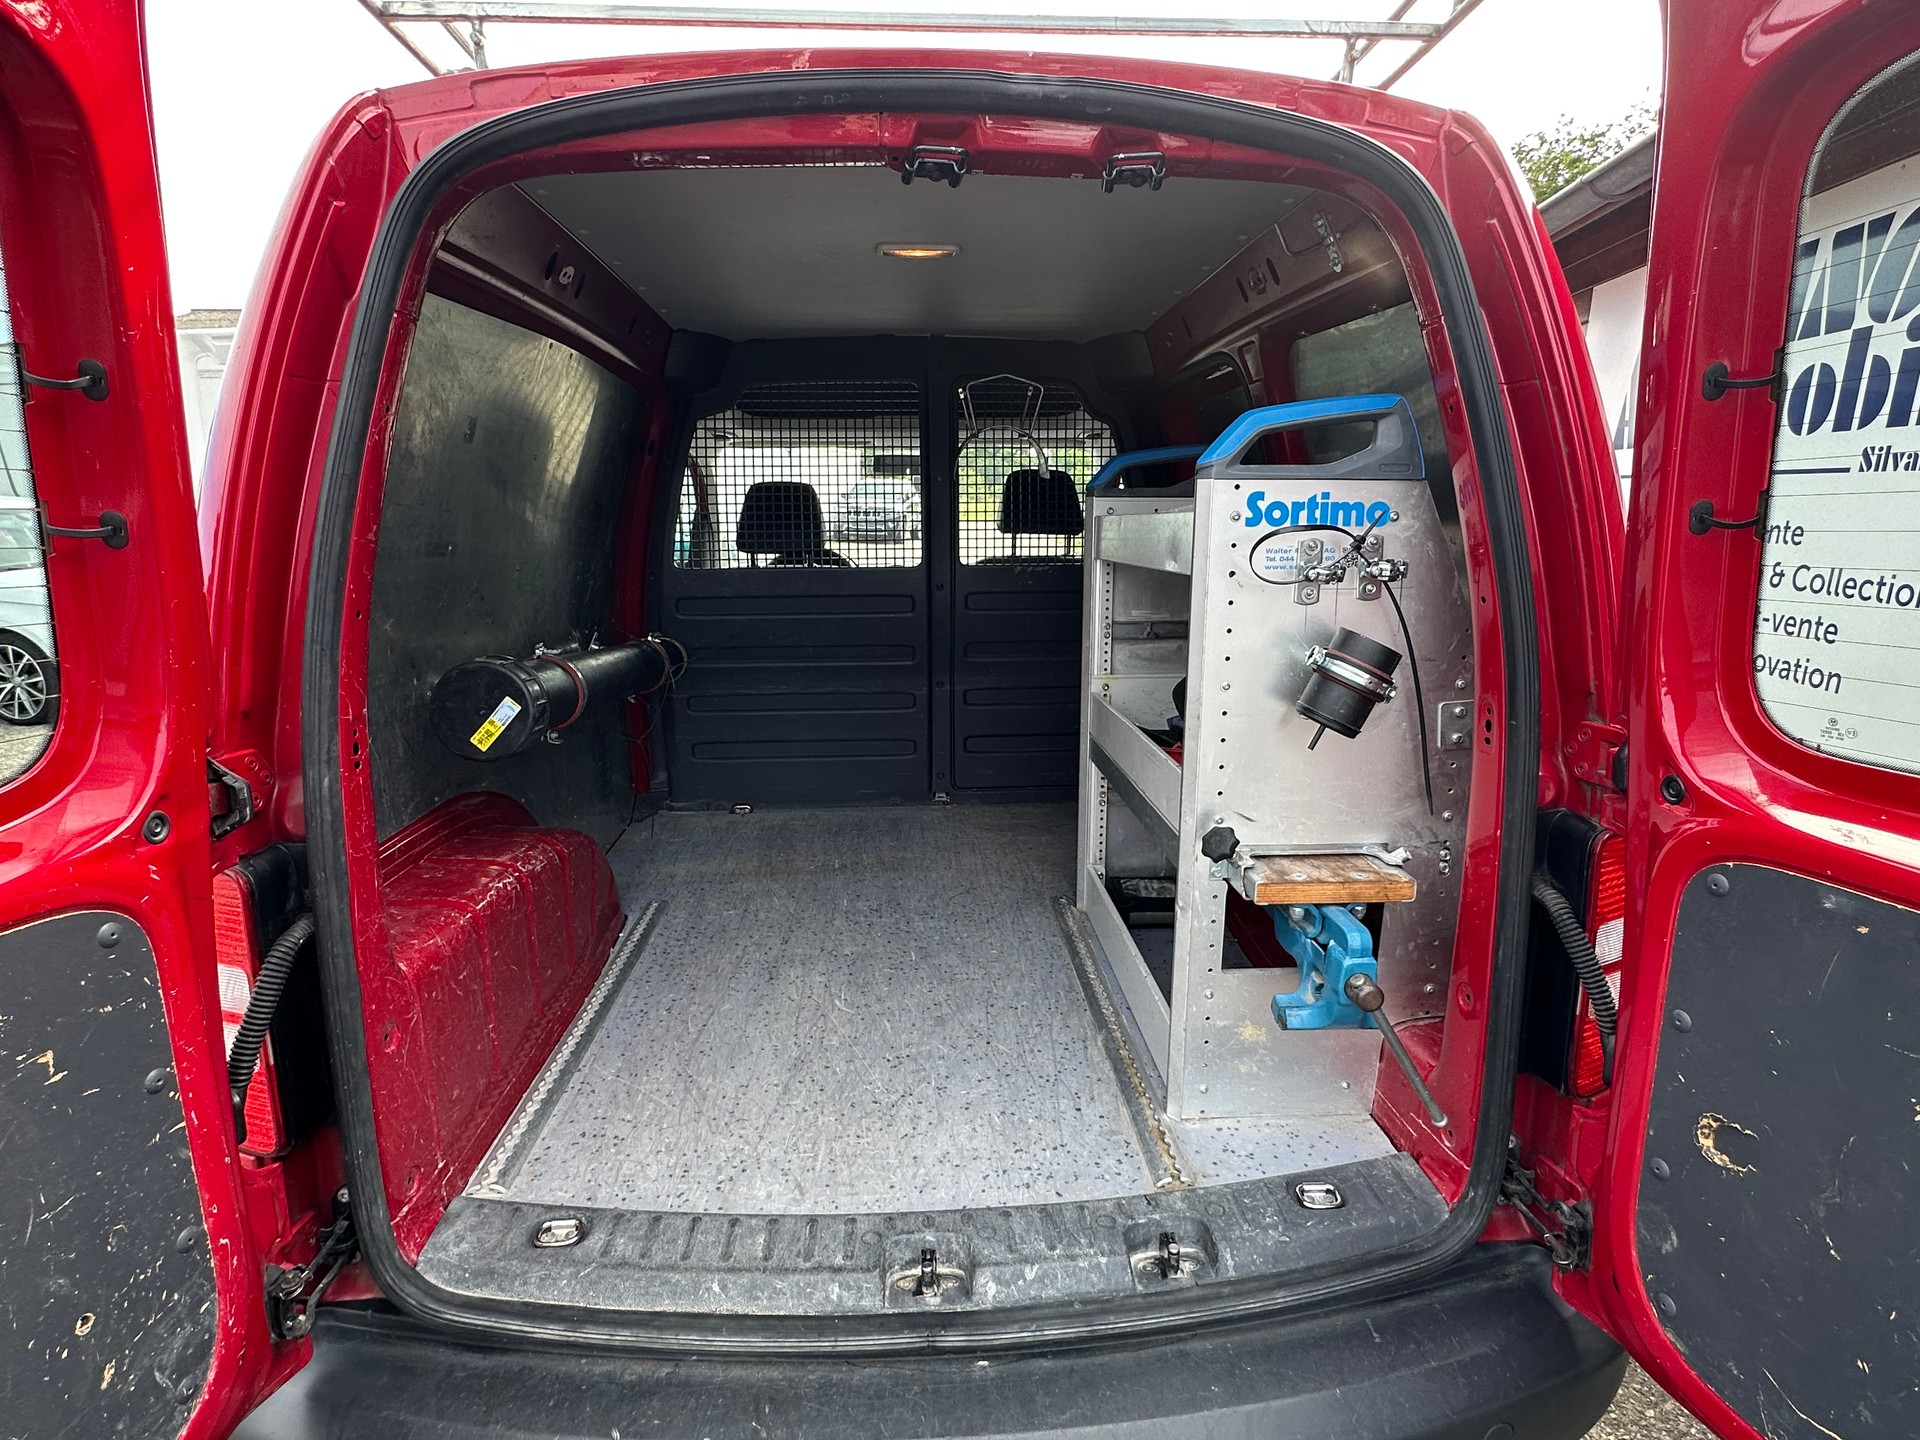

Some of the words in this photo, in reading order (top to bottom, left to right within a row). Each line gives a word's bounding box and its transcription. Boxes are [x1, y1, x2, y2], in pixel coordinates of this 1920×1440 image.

[1787, 313, 1920, 437] obi
[1858, 445, 1920, 473] Silva
[1245, 490, 1391, 528] Sortimo
[1265, 547, 1293, 555] Walter
[1769, 561, 1786, 589] &
[1792, 564, 1920, 609] Collectio
[1761, 612, 1839, 645] -vente
